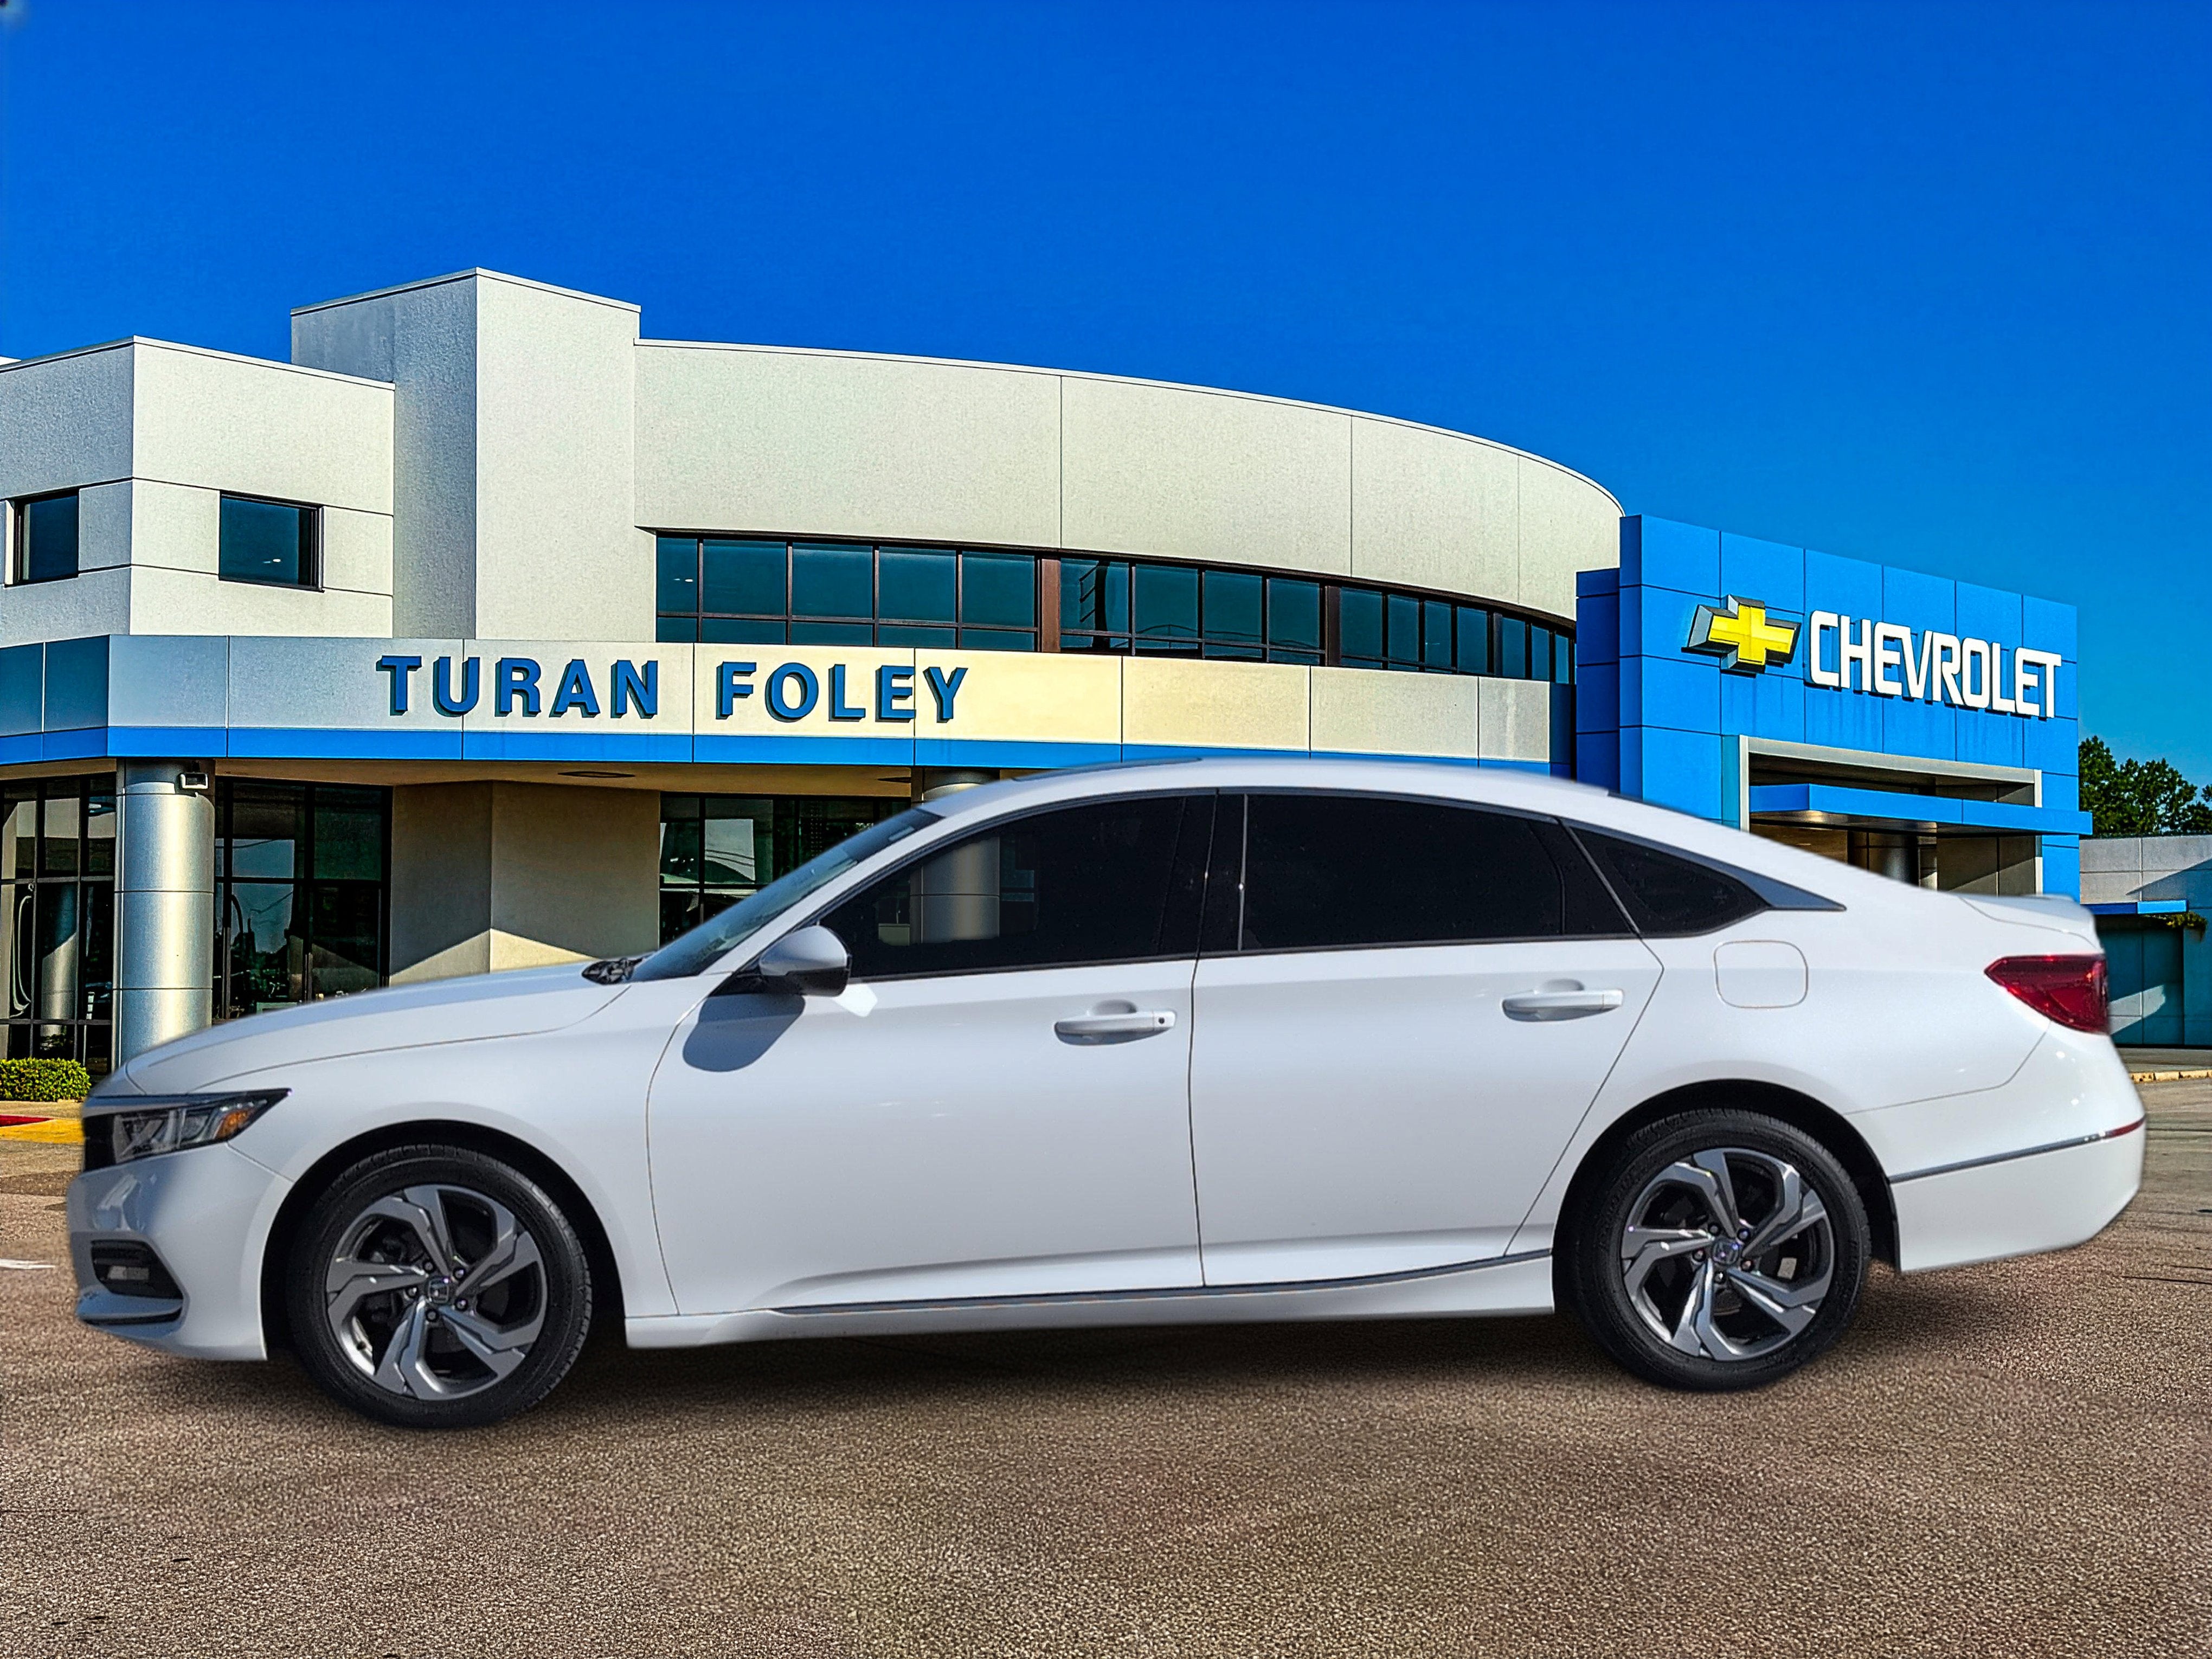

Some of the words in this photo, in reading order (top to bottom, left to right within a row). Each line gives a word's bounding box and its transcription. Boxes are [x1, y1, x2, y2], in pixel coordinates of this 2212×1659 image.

[377, 655, 658, 717] TURAN
[716, 662, 968, 722] FOLEY
[1810, 611, 2062, 718] CHEVROLET
